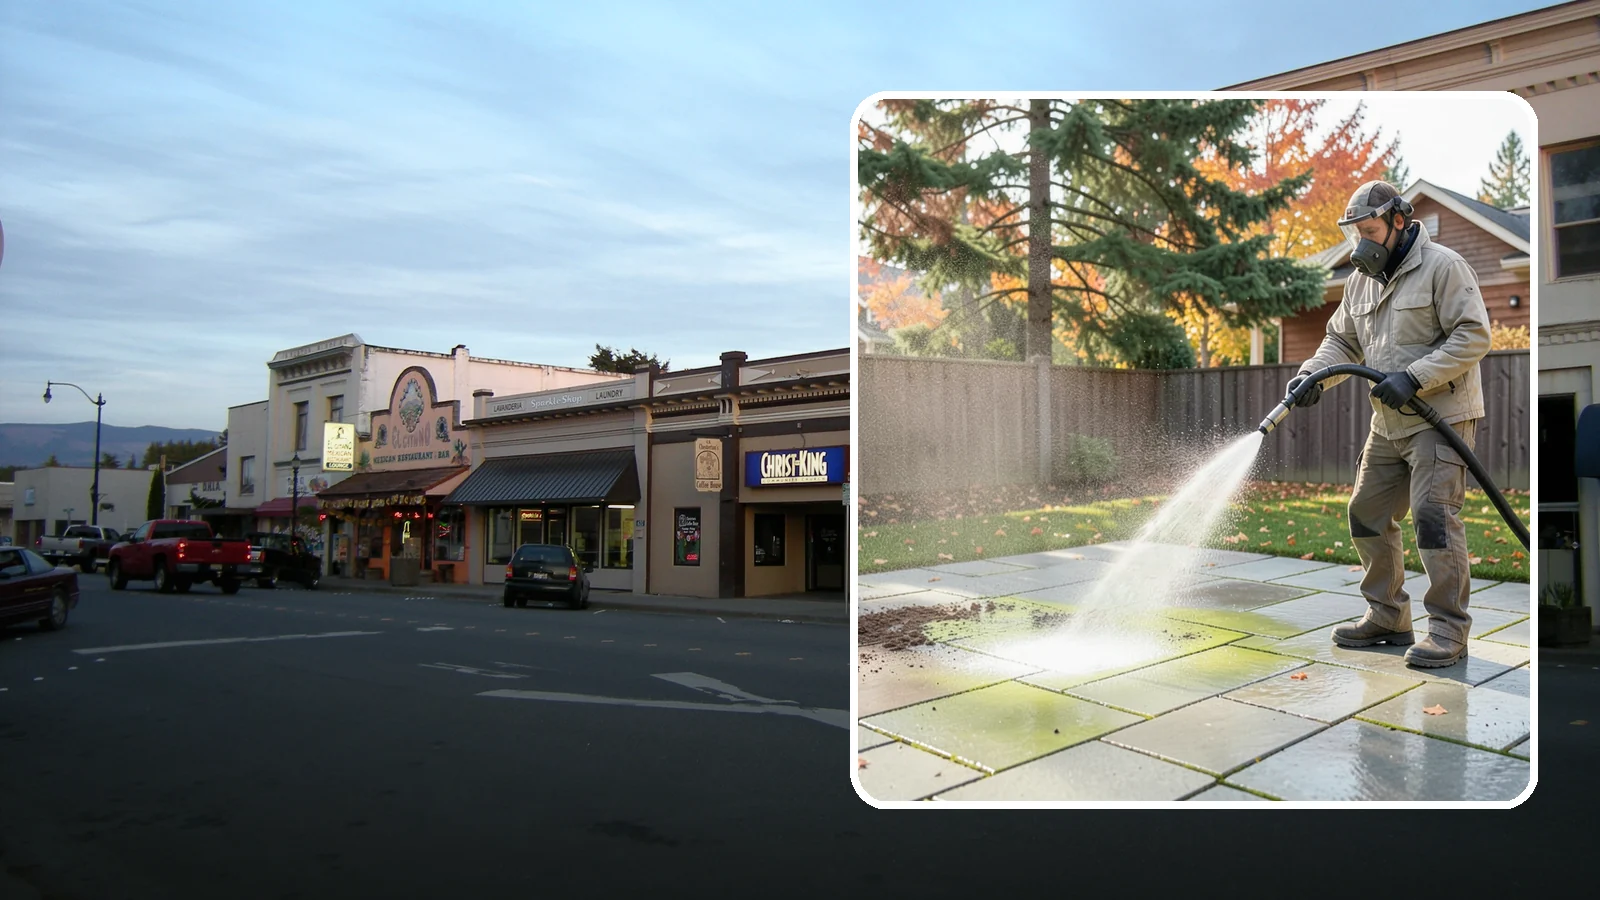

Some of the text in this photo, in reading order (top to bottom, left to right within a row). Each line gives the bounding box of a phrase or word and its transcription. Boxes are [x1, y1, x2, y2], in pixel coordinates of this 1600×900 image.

[595, 389, 623, 399] LAUNDRY
[562, 395, 582, 405] Shop
[493, 402, 522, 412] LAVANDERIA
[373, 455, 396, 464] MEXICAN
[397, 451, 433, 462] RESTAURANT
[438, 450, 450, 459] BAR
[761, 450, 827, 478] CHRIST KING
